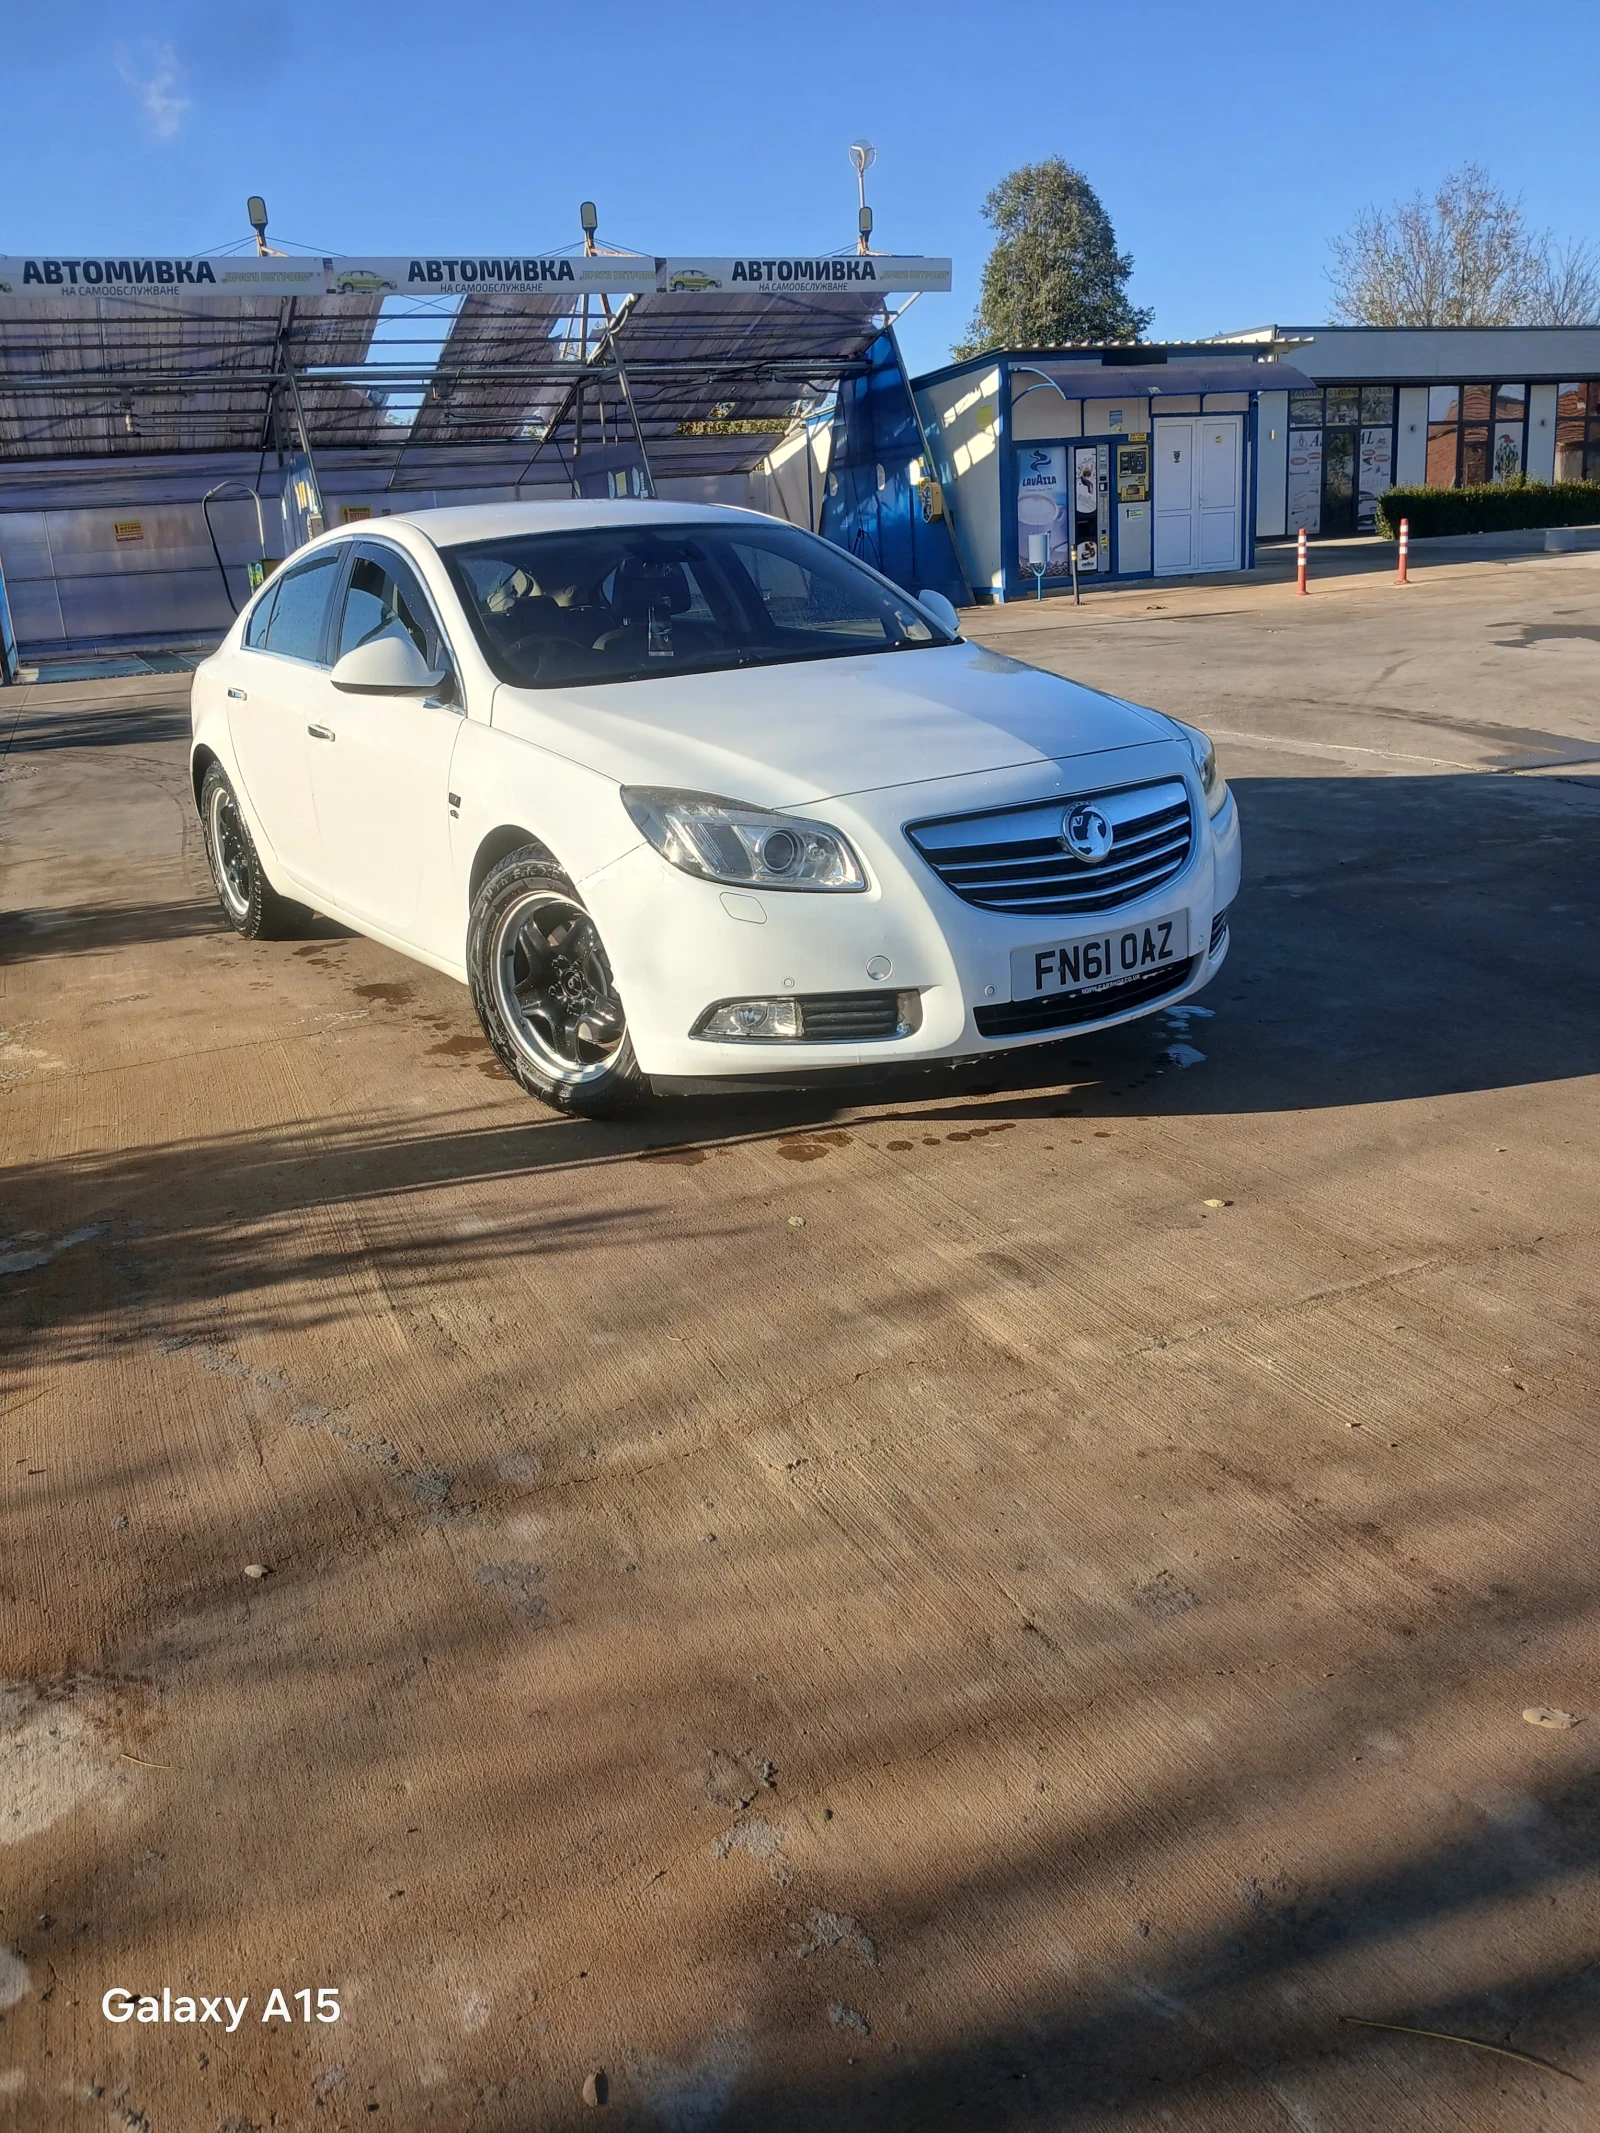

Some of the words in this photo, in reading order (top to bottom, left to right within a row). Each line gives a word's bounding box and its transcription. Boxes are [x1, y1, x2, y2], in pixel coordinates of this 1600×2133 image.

[23, 260, 217, 284] АВТОМИВКА
[408, 260, 575, 282] АВТОМИВКА
[731, 260, 876, 281] АВТОМИВКА
[61, 287, 76, 296] НА
[78, 285, 180, 296] САМООБСЛУЖВАНЕ
[440, 284, 453, 293] НА
[455, 283, 543, 293] САМООБСЛУЖВАНЕ
[758, 283, 770, 291] НА
[771, 282, 848, 291] САМООБСЛУЖВАНЕ
[1022, 474, 1057, 487] LAVAZZA
[1035, 938, 1111, 990] FN61
[1120, 921, 1173, 970] OAZ
